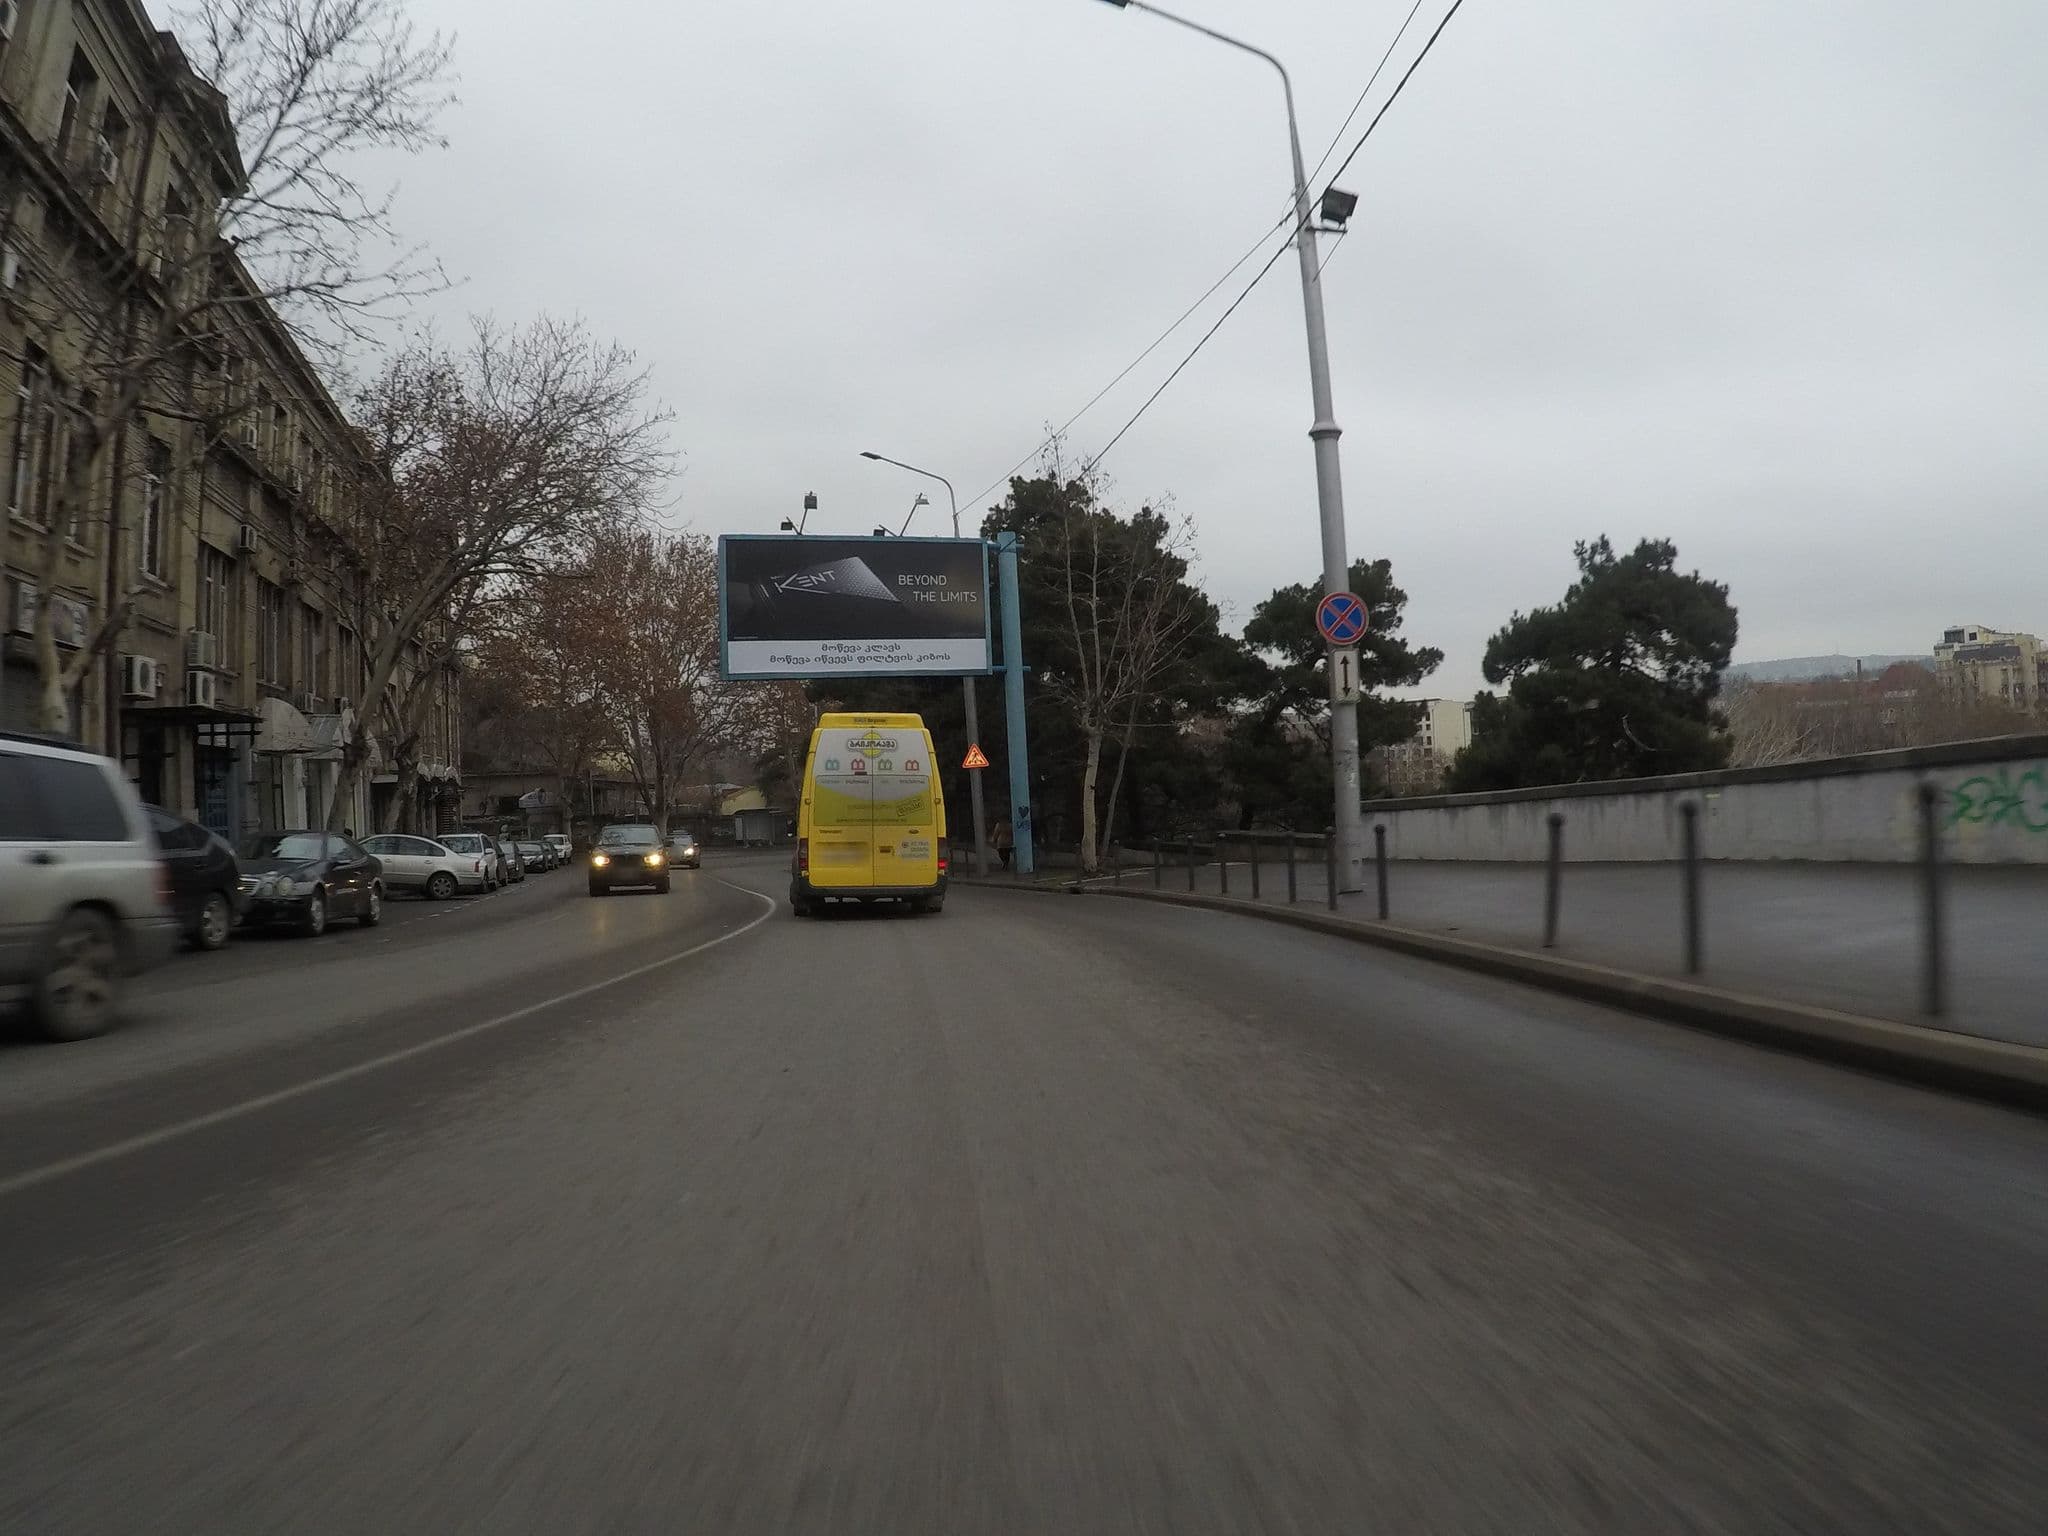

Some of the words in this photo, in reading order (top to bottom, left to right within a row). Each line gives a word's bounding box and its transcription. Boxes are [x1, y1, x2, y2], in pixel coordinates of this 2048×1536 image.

[774, 571, 835, 594] KENT
[898, 574, 947, 586] BEYOND
[913, 591, 937, 602] THE
[940, 591, 977, 602] LIMITS
[821, 643, 862, 653] მოწევა
[865, 643, 901, 653] კლავს
[769, 655, 811, 665] მოწევა
[814, 654, 854, 664] იწვევს
[857, 653, 913, 664] ფილტვის
[916, 653, 951, 663] კიბოს
